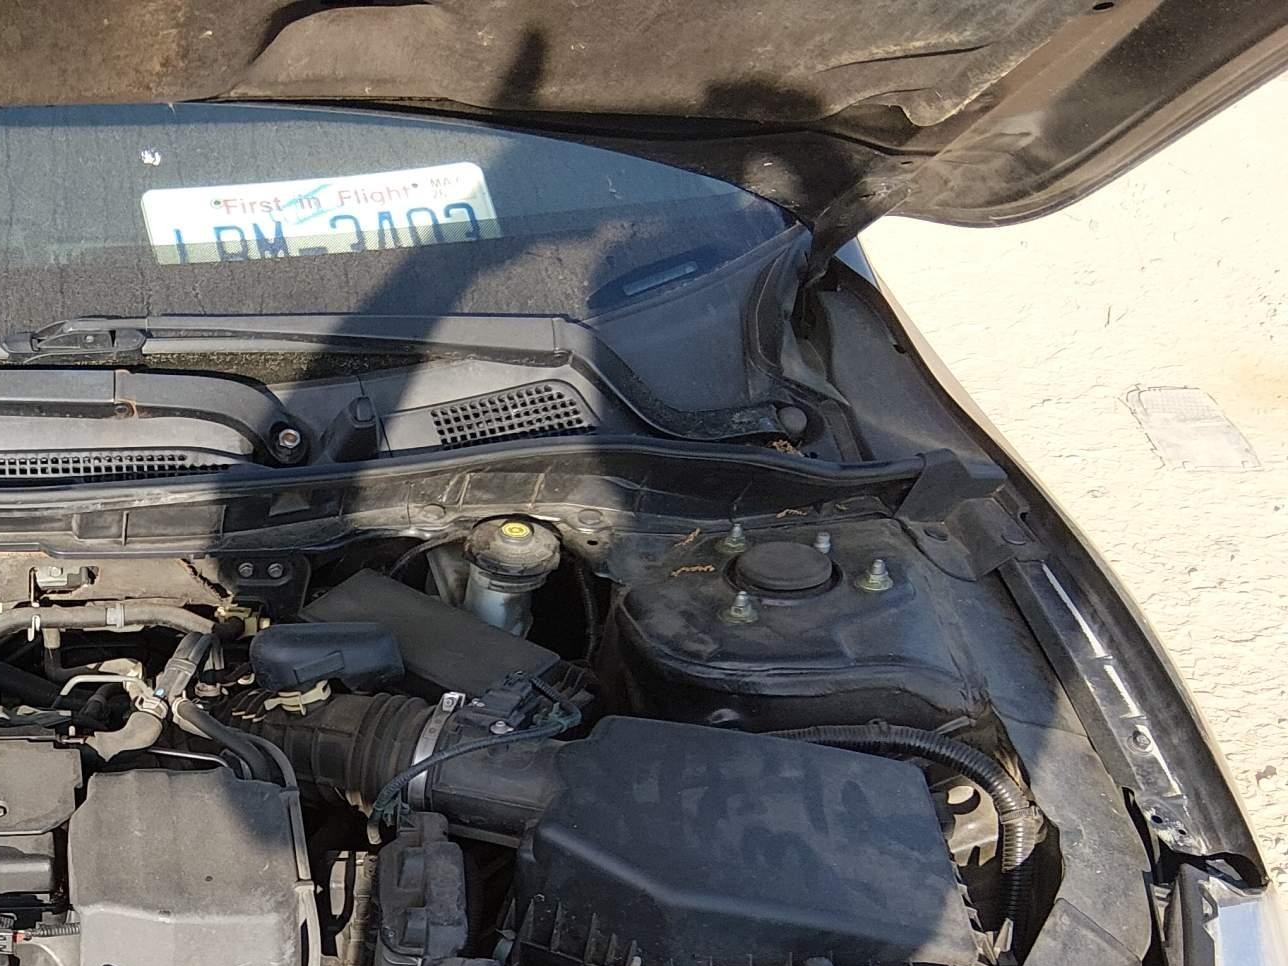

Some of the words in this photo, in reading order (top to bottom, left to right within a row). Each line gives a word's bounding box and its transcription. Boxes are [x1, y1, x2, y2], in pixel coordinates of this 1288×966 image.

[223, 197, 283, 215] First
[298, 194, 322, 210] in
[337, 185, 412, 208] Flight
